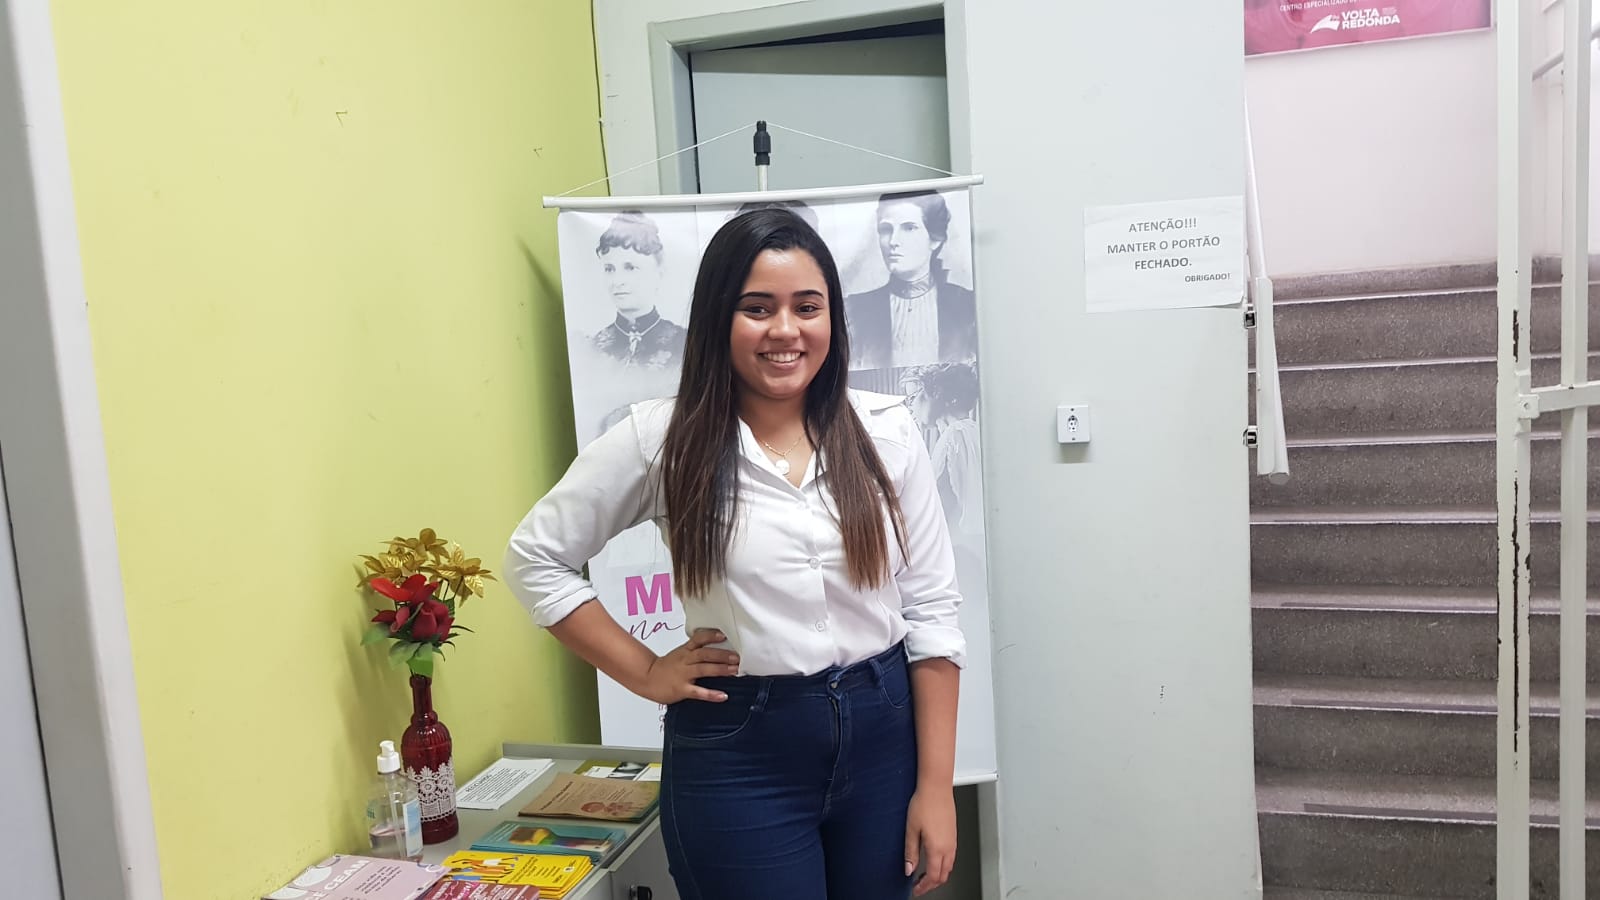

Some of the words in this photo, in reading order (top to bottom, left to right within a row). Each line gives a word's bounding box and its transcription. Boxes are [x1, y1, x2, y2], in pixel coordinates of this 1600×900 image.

[1280, 4, 1302, 12] CENTRO
[1341, 8, 1379, 20] VOLTA
[1341, 15, 1400, 29] REDONDA
[1128, 217, 1197, 233] ATENÇÃO!!!
[1107, 241, 1156, 254] MANTER
[1159, 240, 1169, 250] O
[1172, 235, 1220, 250] PORTÃO
[1134, 257, 1192, 270] FECHADO.
[1184, 272, 1231, 283] OBRIGADO!
